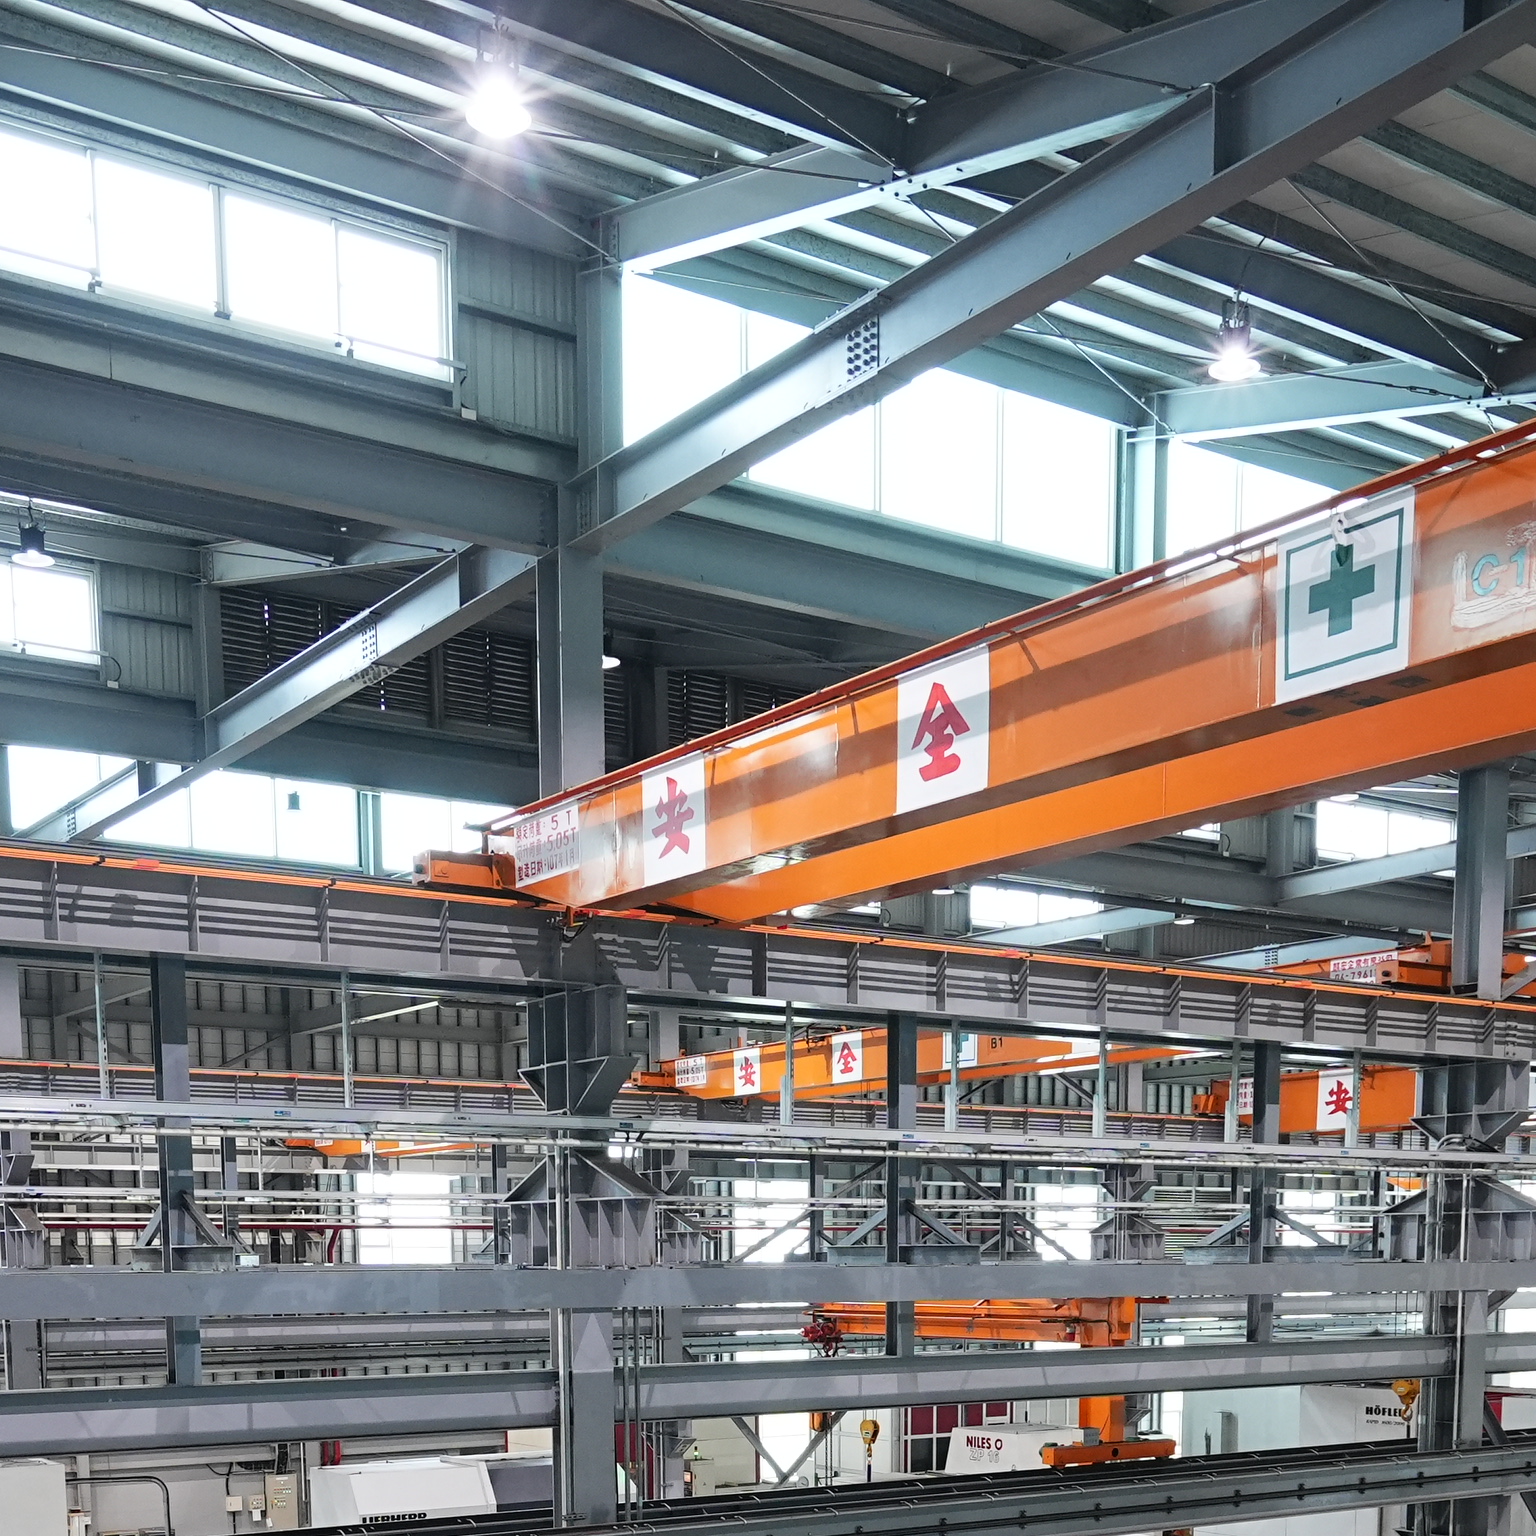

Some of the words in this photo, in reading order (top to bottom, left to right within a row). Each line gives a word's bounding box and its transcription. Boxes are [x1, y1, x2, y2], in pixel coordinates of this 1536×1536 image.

[1472, 546, 1526, 597] C1
[913, 682, 970, 782] 全
[551, 814, 559, 831] 5
[566, 809, 572, 826] T
[652, 776, 695, 860] 安
[838, 1042, 858, 1074] 全
[990, 1036, 1005, 1050] B1
[739, 1056, 757, 1087] 安
[1325, 1080, 1354, 1115] 安
[1365, 1404, 1402, 1417] HÖFLE
[966, 1435, 992, 1450] NILES
